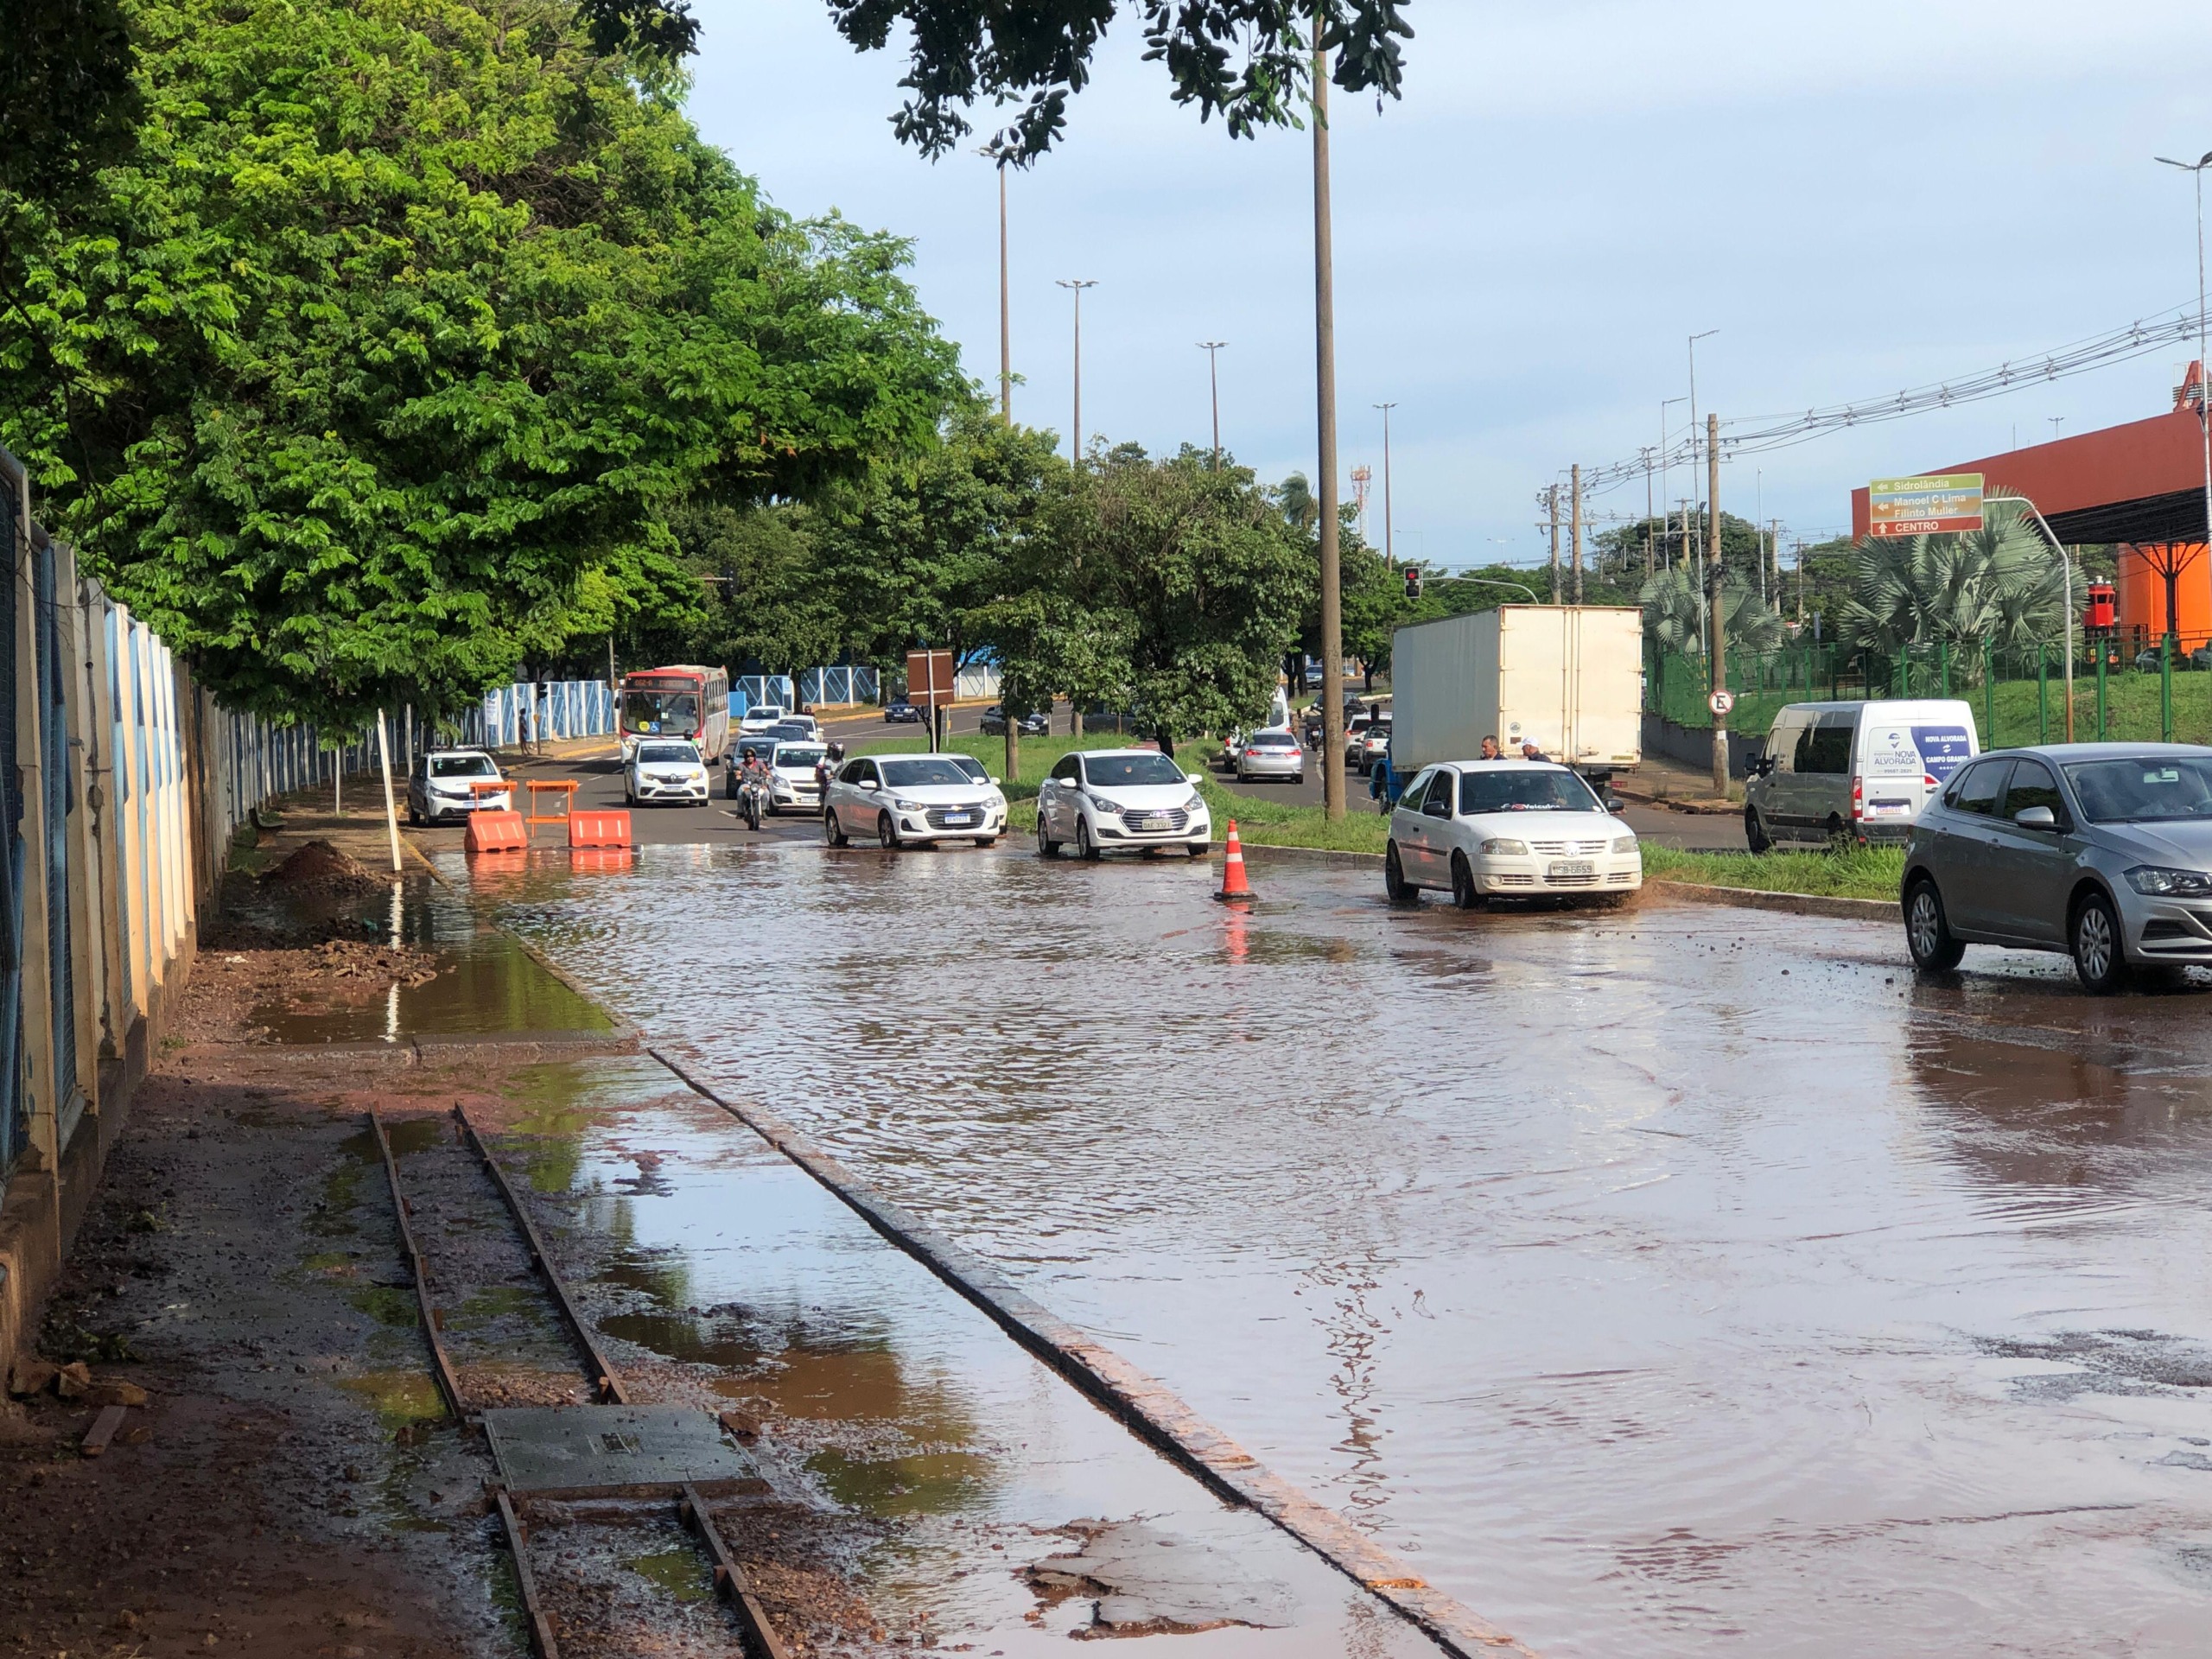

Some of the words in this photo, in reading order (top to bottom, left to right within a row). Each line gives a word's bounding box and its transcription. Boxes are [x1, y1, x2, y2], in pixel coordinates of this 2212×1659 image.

[1894, 480, 1950, 491] Sidrolândia
[1894, 496, 1929, 506] Manoel
[1932, 494, 1940, 504] C
[1942, 493, 1967, 504] Lima
[1894, 508, 1925, 518] Filinto
[1928, 506, 1959, 517] Muller
[1895, 521, 1939, 532] CENTRO
[1716, 695, 1726, 709] E
[1894, 750, 1916, 759] NOVA
